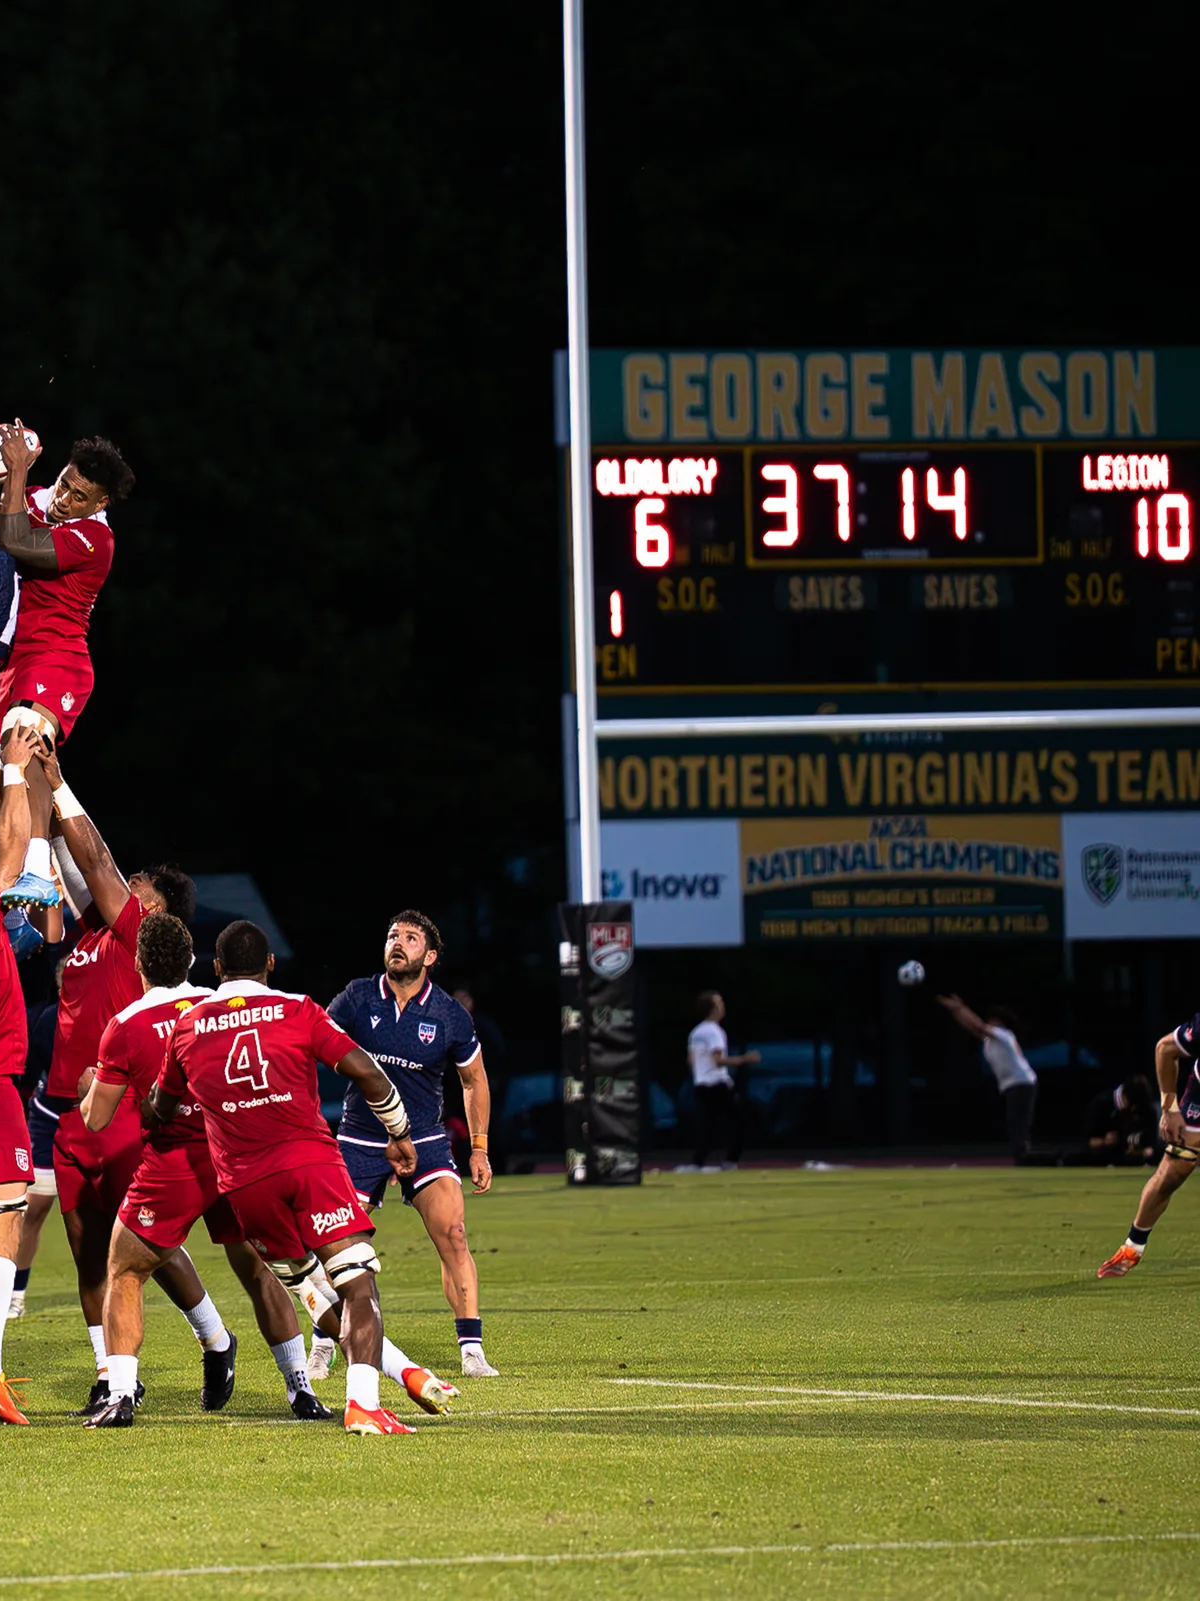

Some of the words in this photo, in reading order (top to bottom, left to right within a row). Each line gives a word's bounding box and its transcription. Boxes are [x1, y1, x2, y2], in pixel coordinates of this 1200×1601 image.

[622, 351, 892, 441] GEORGE
[911, 350, 1157, 438] MASON
[1083, 454, 1169, 491] LEGION
[634, 498, 671, 568] 6
[1136, 493, 1191, 561] 10
[788, 575, 865, 612] SAVES
[923, 573, 999, 610] SAVES
[838, 748, 1078, 807] VIRGINIA'S
[745, 841, 885, 885] NATIONAL
[889, 840, 1061, 881] CHAMPIONS
[632, 867, 721, 898] Inova
[591, 926, 628, 944] MLR
[194, 1004, 284, 1035] NASOQEQE
[225, 1028, 269, 1091] 4
[238, 1097, 270, 1110] Cedars
[269, 1092, 292, 1103] Sinai
